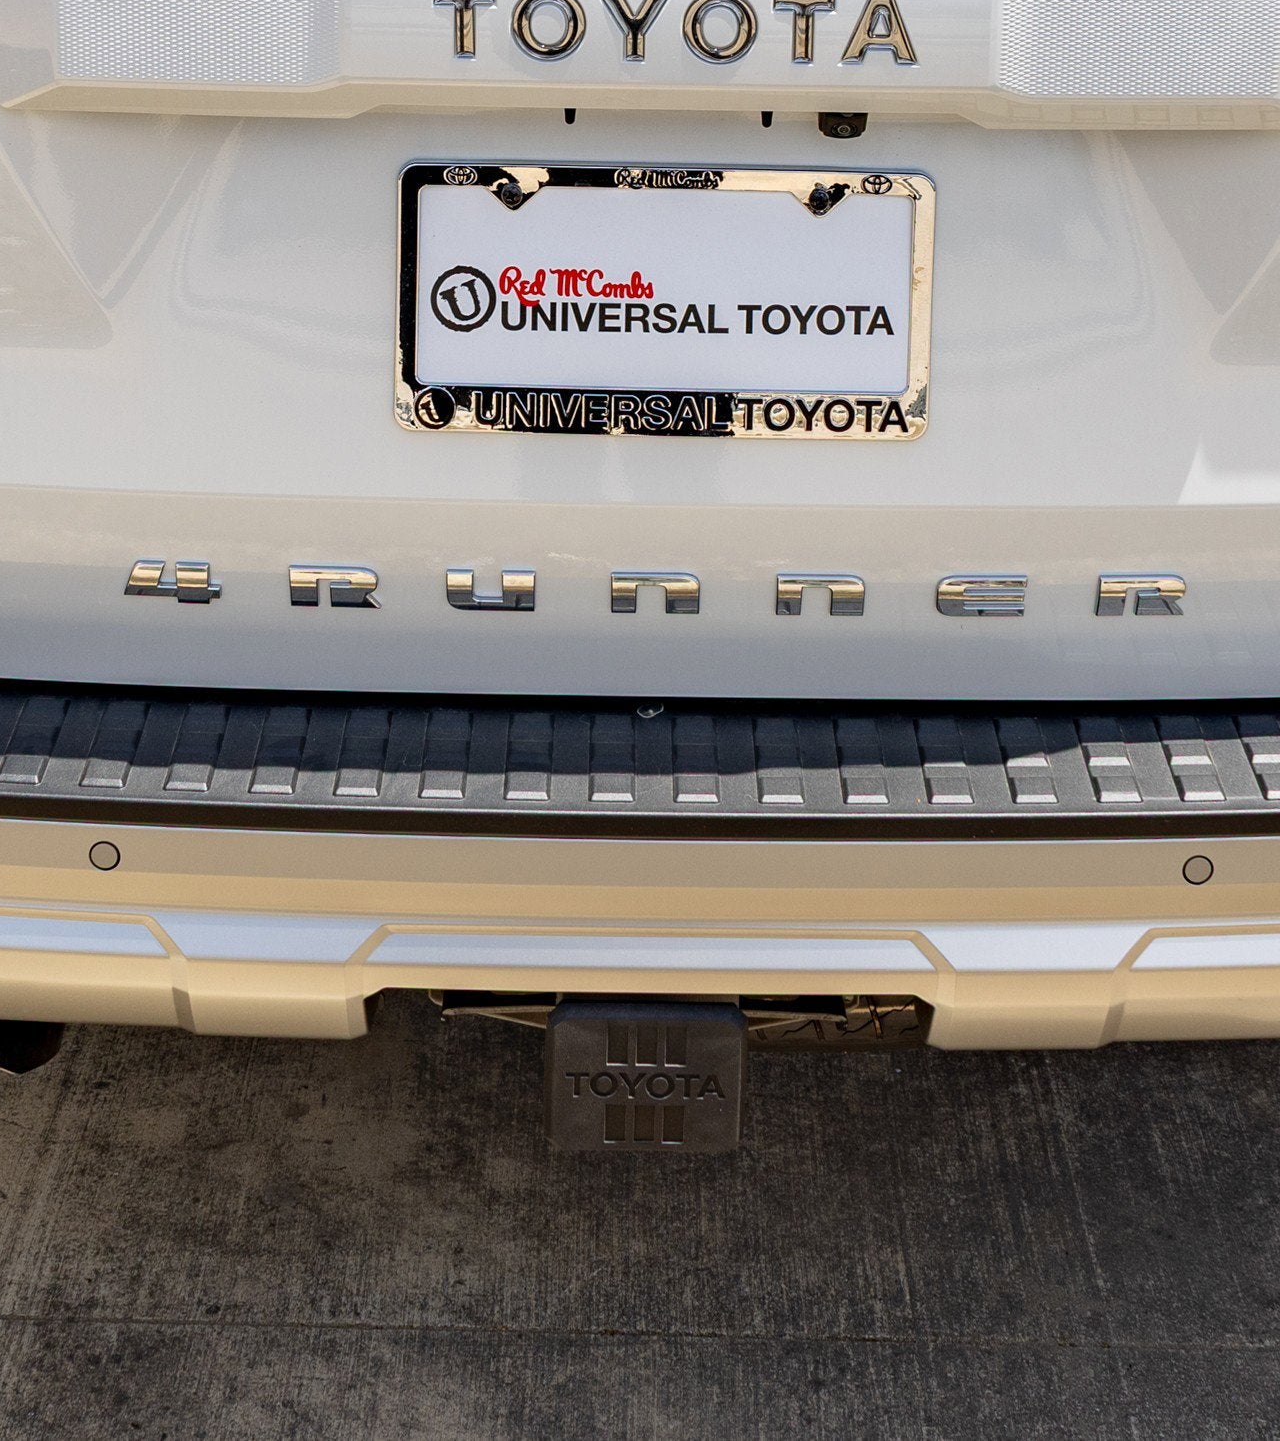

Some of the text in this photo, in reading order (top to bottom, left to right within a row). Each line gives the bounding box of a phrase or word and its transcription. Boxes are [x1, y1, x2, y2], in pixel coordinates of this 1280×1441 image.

[614, 167, 722, 190] Red McCombs
[498, 266, 655, 308] Red McCombs
[501, 301, 895, 336] UNIVERSAL TOYOTA
[474, 391, 909, 434] UNIVERSAL TOYOTA
[565, 1071, 726, 1100] TOYOTA
